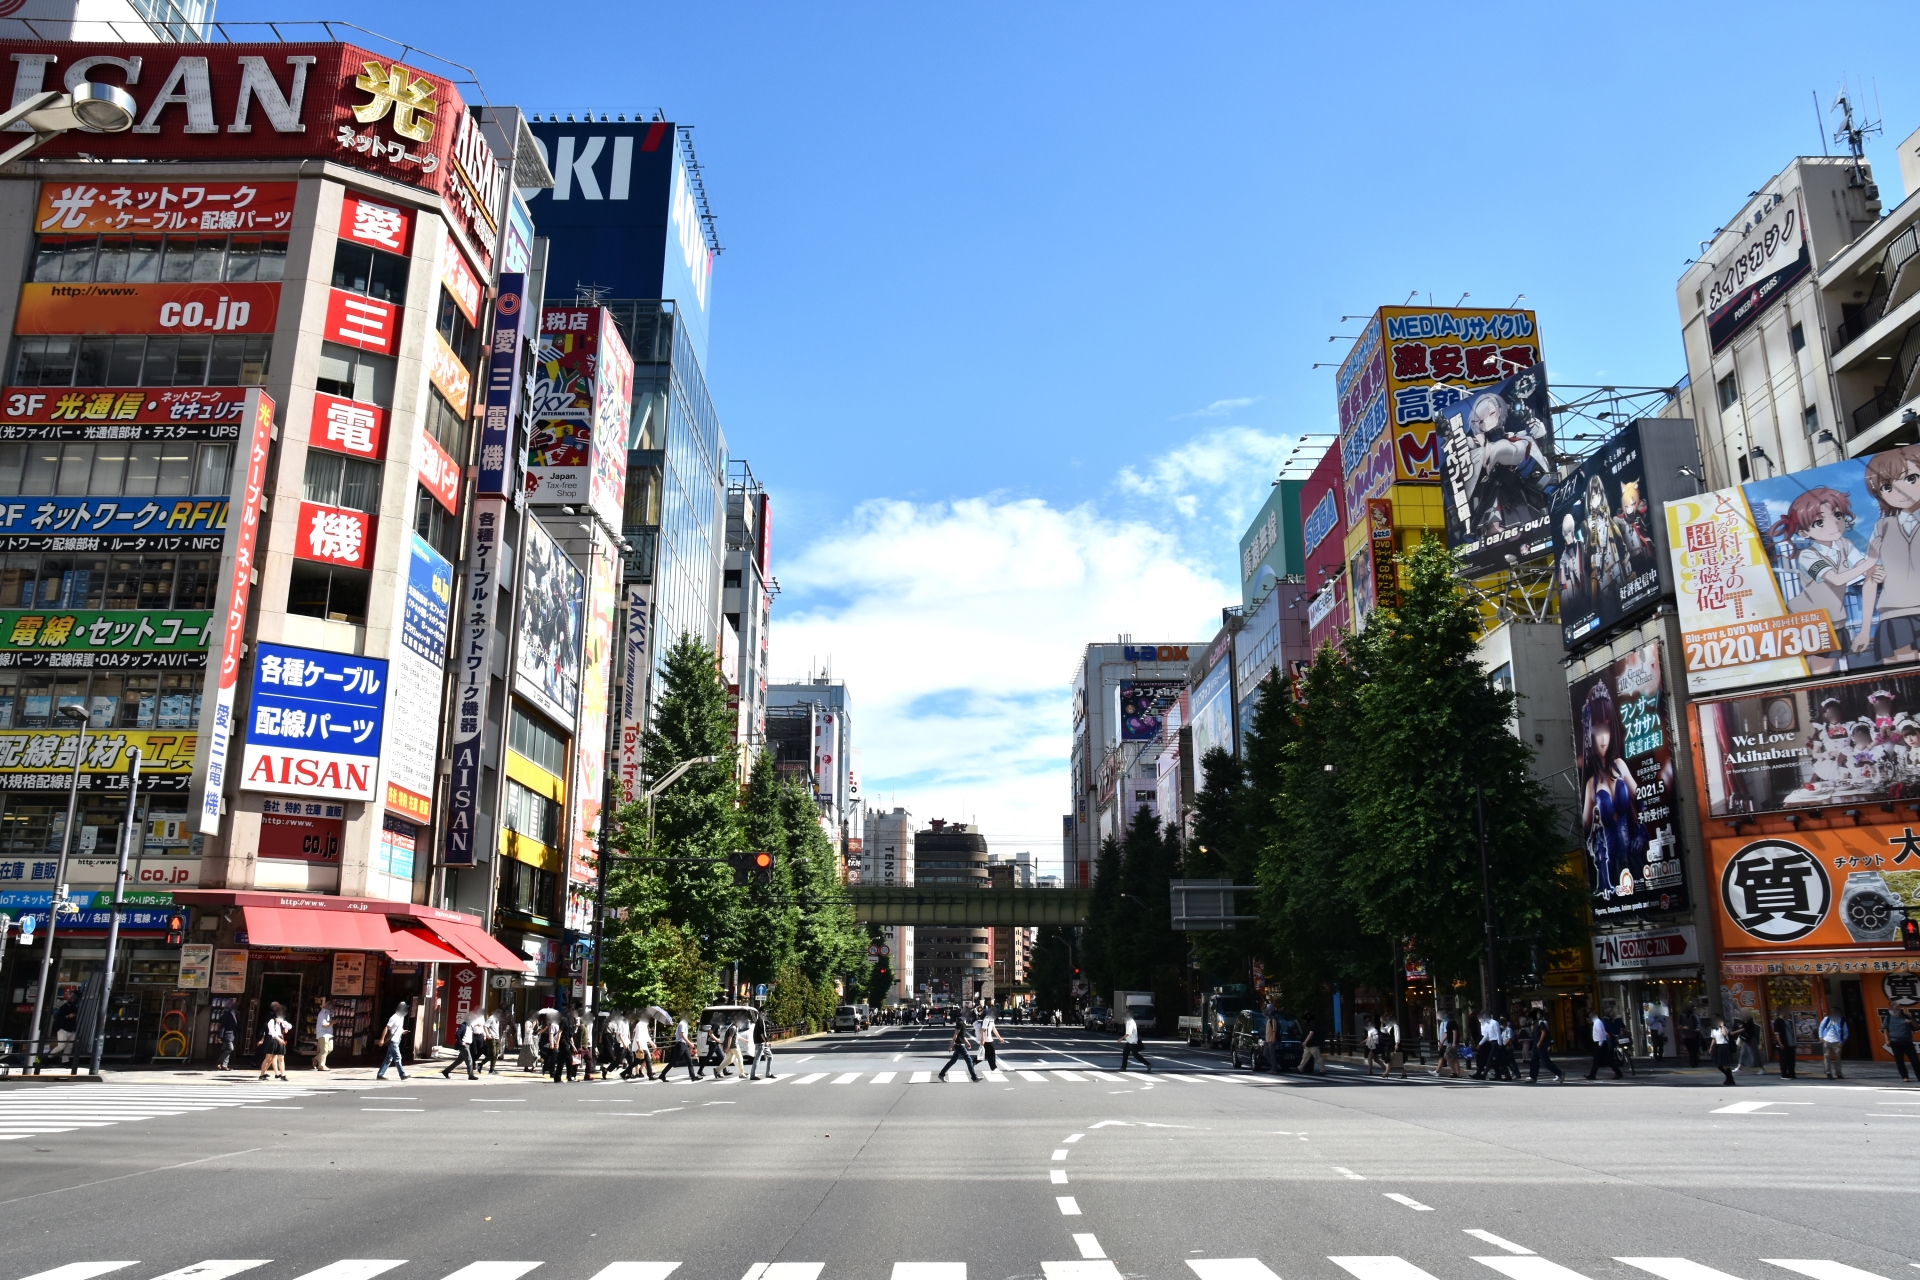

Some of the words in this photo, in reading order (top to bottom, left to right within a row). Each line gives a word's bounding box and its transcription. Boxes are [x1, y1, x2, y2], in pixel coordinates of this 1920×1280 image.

[352, 61, 437, 143] 光
[336, 125, 440, 174] ネットワーク
[41, 186, 97, 230] 光
[1709, 208, 1795, 311] メイドカジノ
[51, 285, 138, 298] http://www.
[160, 297, 250, 330] co.jp
[541, 312, 589, 331] 税店
[1387, 313, 1533, 342] MEDIAリサイクル
[6, 393, 46, 416] 3F
[481, 328, 516, 472] 愛三電機
[1304, 488, 1338, 559] SEGA
[629, 592, 647, 653] AKKY
[1685, 631, 1717, 644] Blu-ray
[1727, 626, 1746, 637] DVD
[1687, 624, 1821, 671] 2020.4/30
[261, 654, 380, 695] 各種ケーブル
[254, 706, 374, 744] 配線パーツ
[1624, 714, 1661, 740] スカサハ
[1732, 735, 1756, 747] We
[1758, 732, 1796, 745] Love
[1725, 747, 1809, 765] Akihabara
[248, 754, 370, 791] AISAN
[451, 748, 474, 850] AISAN
[1636, 780, 1665, 800] 2021.5
[302, 831, 339, 859] co.jp
[140, 866, 189, 883] co.jp
[1834, 854, 1886, 869] チケット
[1621, 941, 1653, 958] COMIC
[1656, 939, 1670, 954] ZIN
